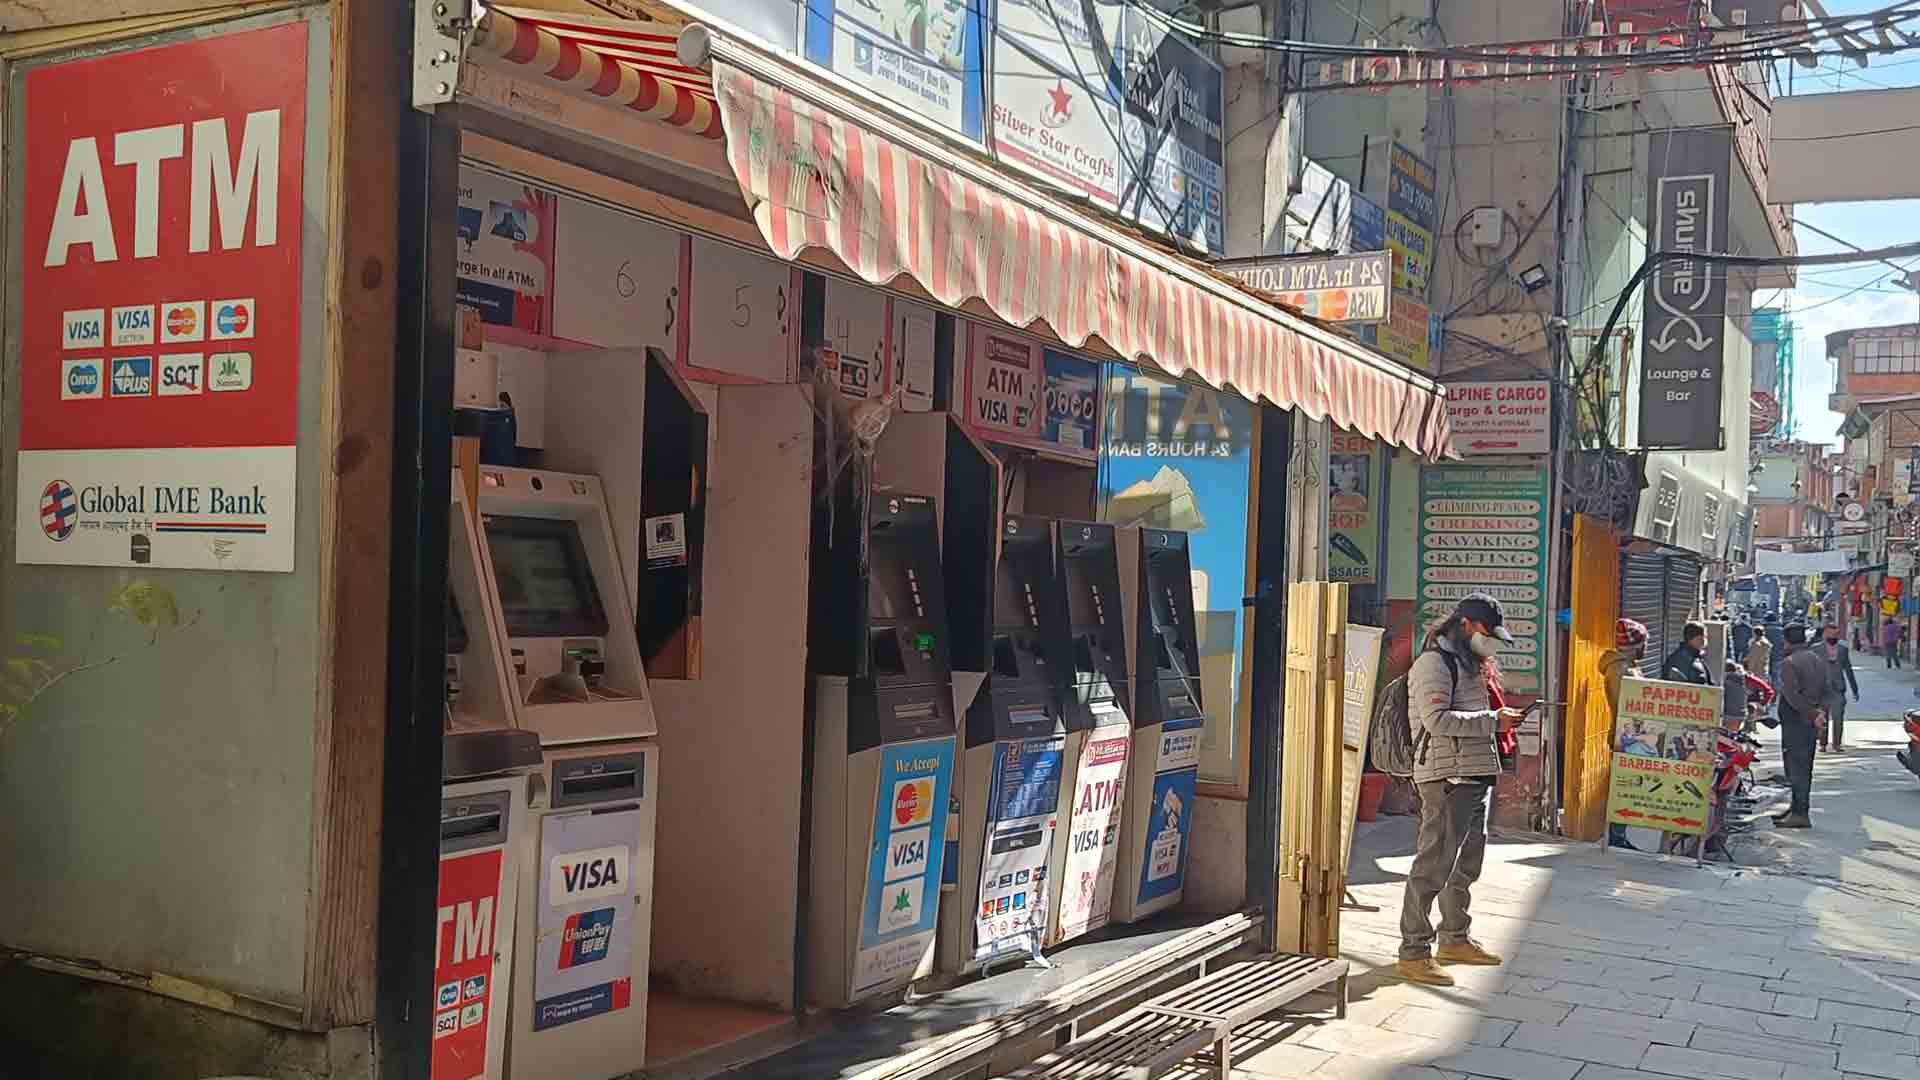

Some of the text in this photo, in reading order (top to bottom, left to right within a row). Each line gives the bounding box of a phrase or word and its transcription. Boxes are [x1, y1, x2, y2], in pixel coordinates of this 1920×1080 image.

[992, 103, 1035, 137] Silver
[1040, 128, 1070, 154] Star
[1074, 146, 1115, 178] Crafts
[44, 109, 281, 268] ATM
[493, 267, 504, 281] all
[507, 269, 535, 287] ATMs
[617, 260, 638, 298] 6
[729, 284, 753, 328] 5
[68, 320, 100, 340] VISA
[117, 310, 150, 330] VISA
[123, 376, 150, 393] PLUS
[163, 364, 200, 387] SCT
[986, 366, 1023, 398] ATM
[1647, 368, 1713, 381] Lounge &
[1496, 387, 1546, 400] CARGO
[1666, 389, 1691, 401] Bar
[979, 396, 1008, 424] VISA
[1484, 405, 1493, 415] &
[1498, 404, 1547, 415] Courier
[80, 485, 267, 514] Global IME Bank
[1440, 519, 1526, 529] TREKKING
[1438, 536, 1526, 547] KAYAKING
[1438, 552, 1525, 563] RAFTING
[1642, 686, 1700, 705] PAPPU
[1626, 699, 1714, 721] HAIR DRESSER
[896, 755, 941, 772] We Accept
[1618, 755, 1670, 776] BARBER
[1081, 779, 1120, 814] ATM
[1074, 829, 1099, 854] VISA
[892, 839, 924, 867] VISA
[561, 857, 620, 893] VISA
[437, 895, 494, 969] TM
[565, 922, 612, 943] UnionPay
[437, 1015, 457, 1032] SCT
